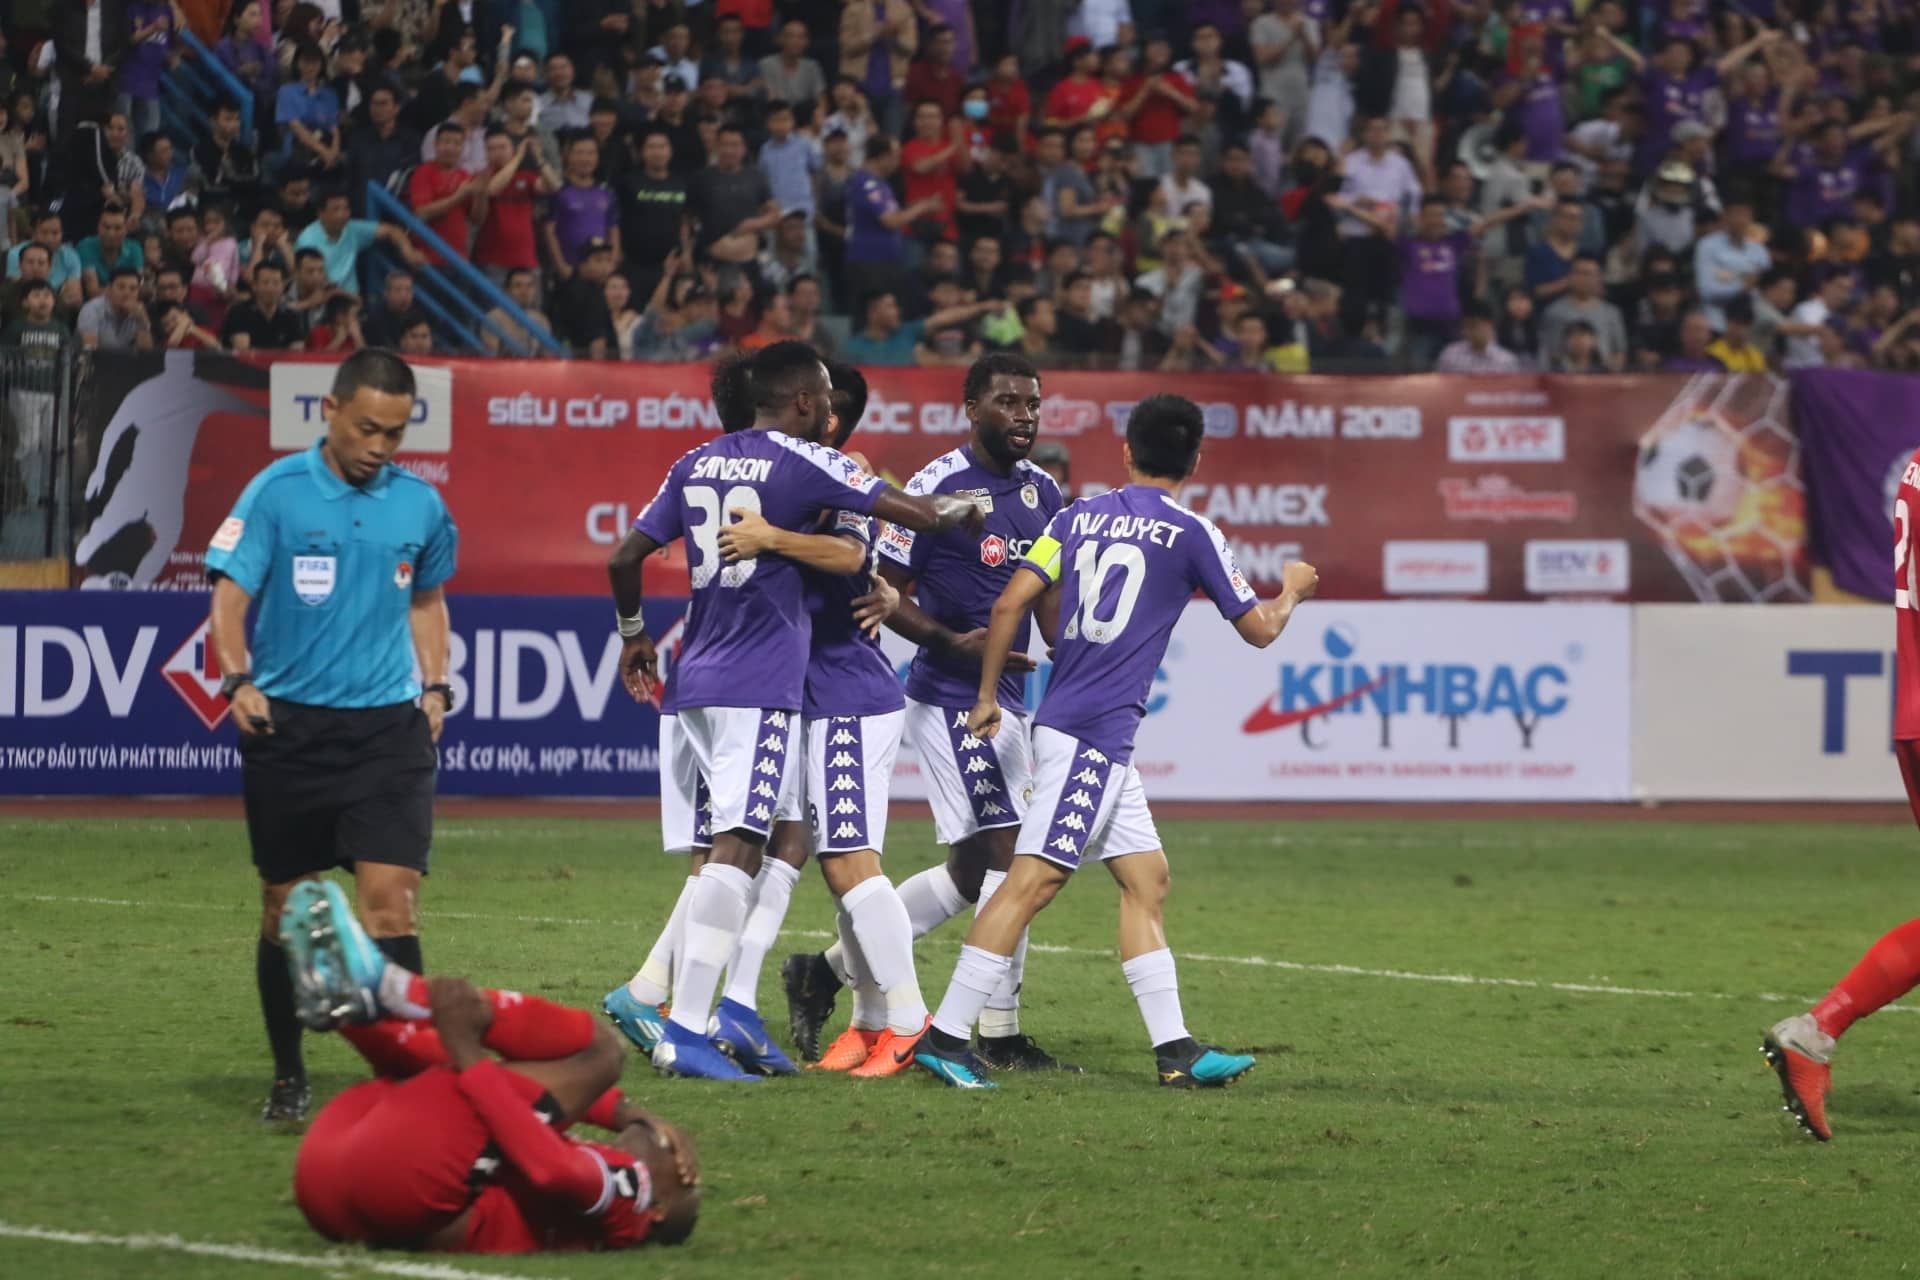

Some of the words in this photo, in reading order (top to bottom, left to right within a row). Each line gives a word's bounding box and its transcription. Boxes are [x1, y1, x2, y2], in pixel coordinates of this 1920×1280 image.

[487, 391, 557, 426] SIÊU
[564, 394, 630, 428] CÚP
[636, 391, 724, 429] BÓN
[852, 391, 913, 433] ỐC
[1245, 399, 1334, 437] NĂM
[584, 502, 630, 544] CL
[1079, 482, 1329, 525] CAMEX
[890, 530, 913, 548] VPF
[1008, 537, 1034, 561] SC
[298, 559, 330, 572] FIFA
[1064, 540, 1146, 645] 10
[0, 625, 160, 717] IDV
[1279, 662, 1570, 717] KINHBAC
[1787, 651, 1896, 755] T
[1300, 711, 1541, 750] CITY
[7, 746, 46, 769] TMCP
[79, 745, 99, 769] TƯ
[99, 744, 118, 769] VÀ
[120, 743, 157, 769] PHÁT
[201, 743, 232, 774] VIỆT
[469, 746, 495, 771] CƠ
[497, 743, 536, 777] HỘI,
[540, 746, 578, 776] HỢP
[582, 744, 613, 771] TÁC
[616, 744, 661, 772] THÀN
